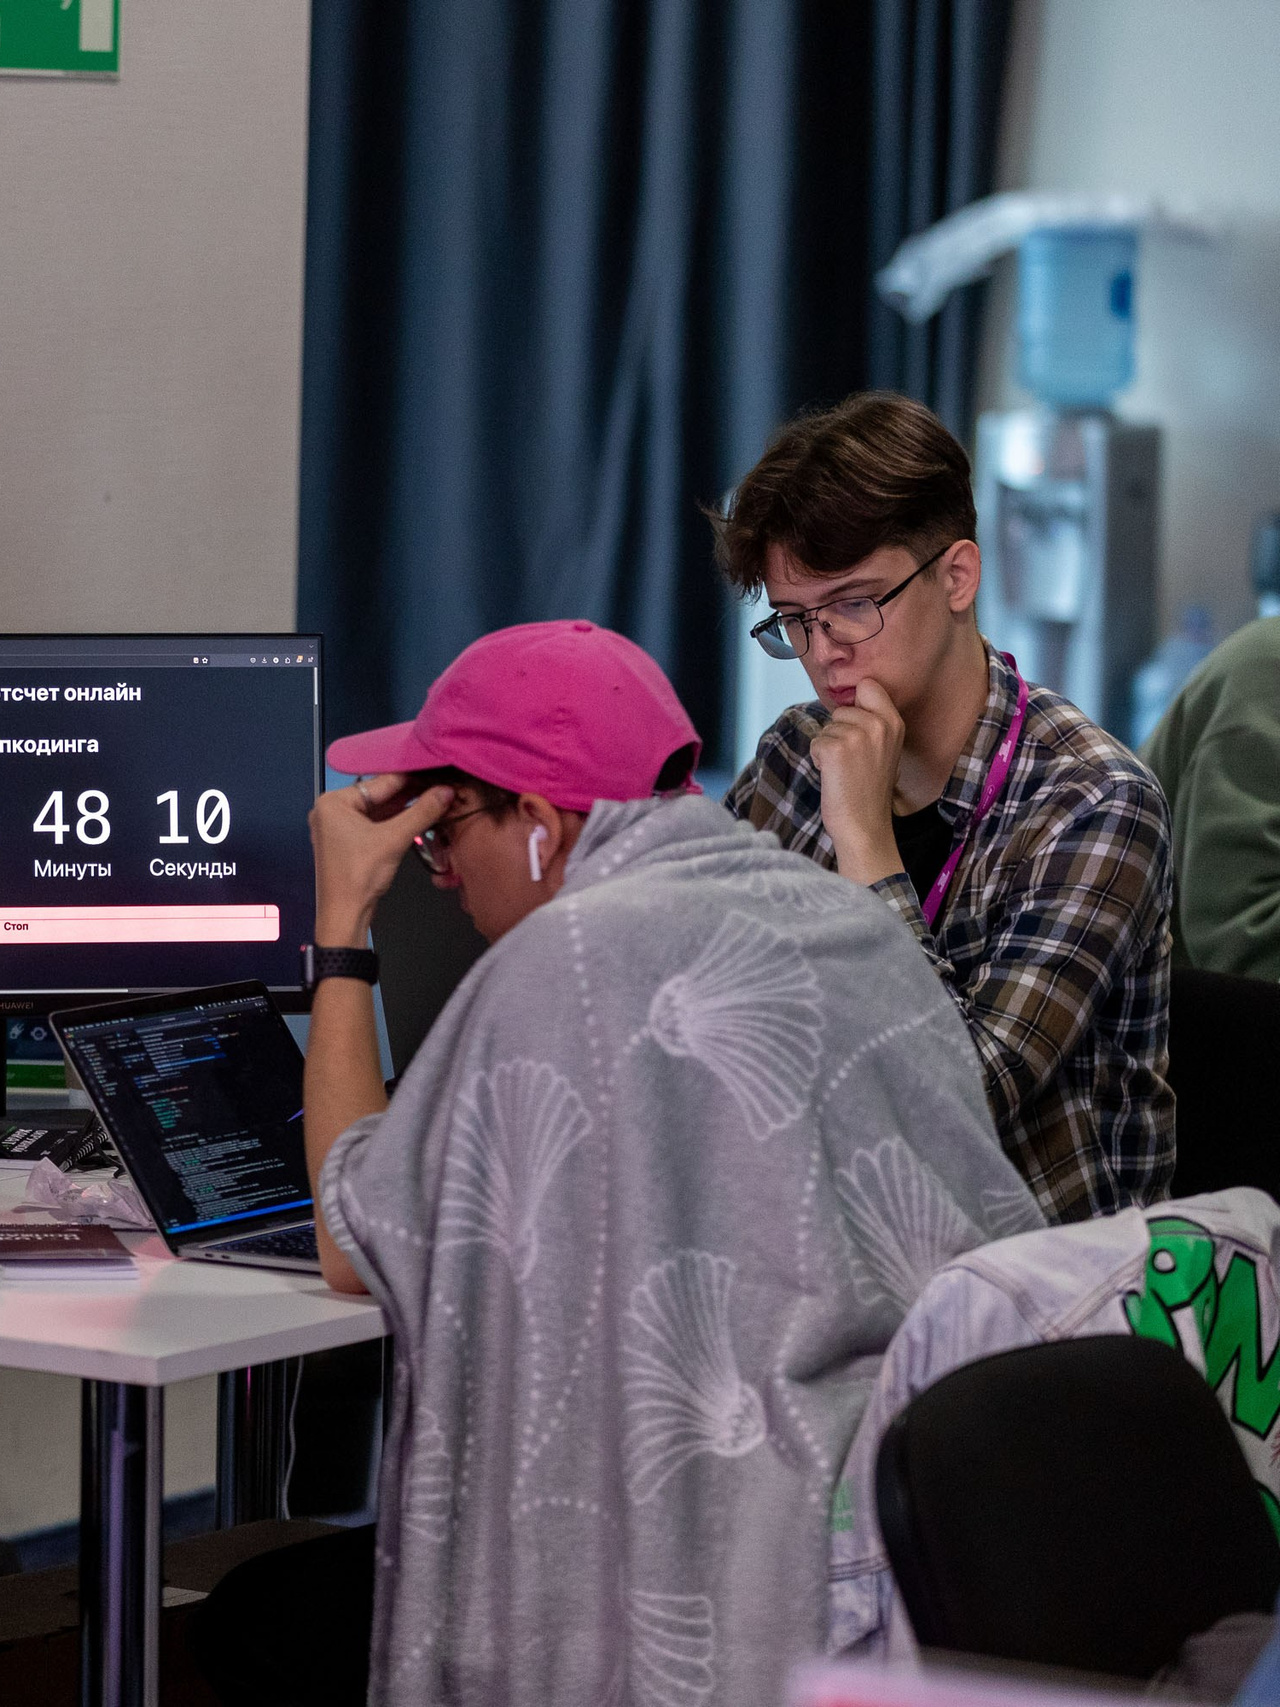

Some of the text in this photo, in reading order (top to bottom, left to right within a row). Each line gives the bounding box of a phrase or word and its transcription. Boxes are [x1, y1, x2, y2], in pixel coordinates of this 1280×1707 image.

[64, 683, 142, 702] онлайн
[32, 789, 111, 846] 48
[156, 788, 232, 845] 10
[34, 859, 112, 881] Минуты
[149, 857, 237, 881] Секунды
[3, 921, 30, 933] Стоп
